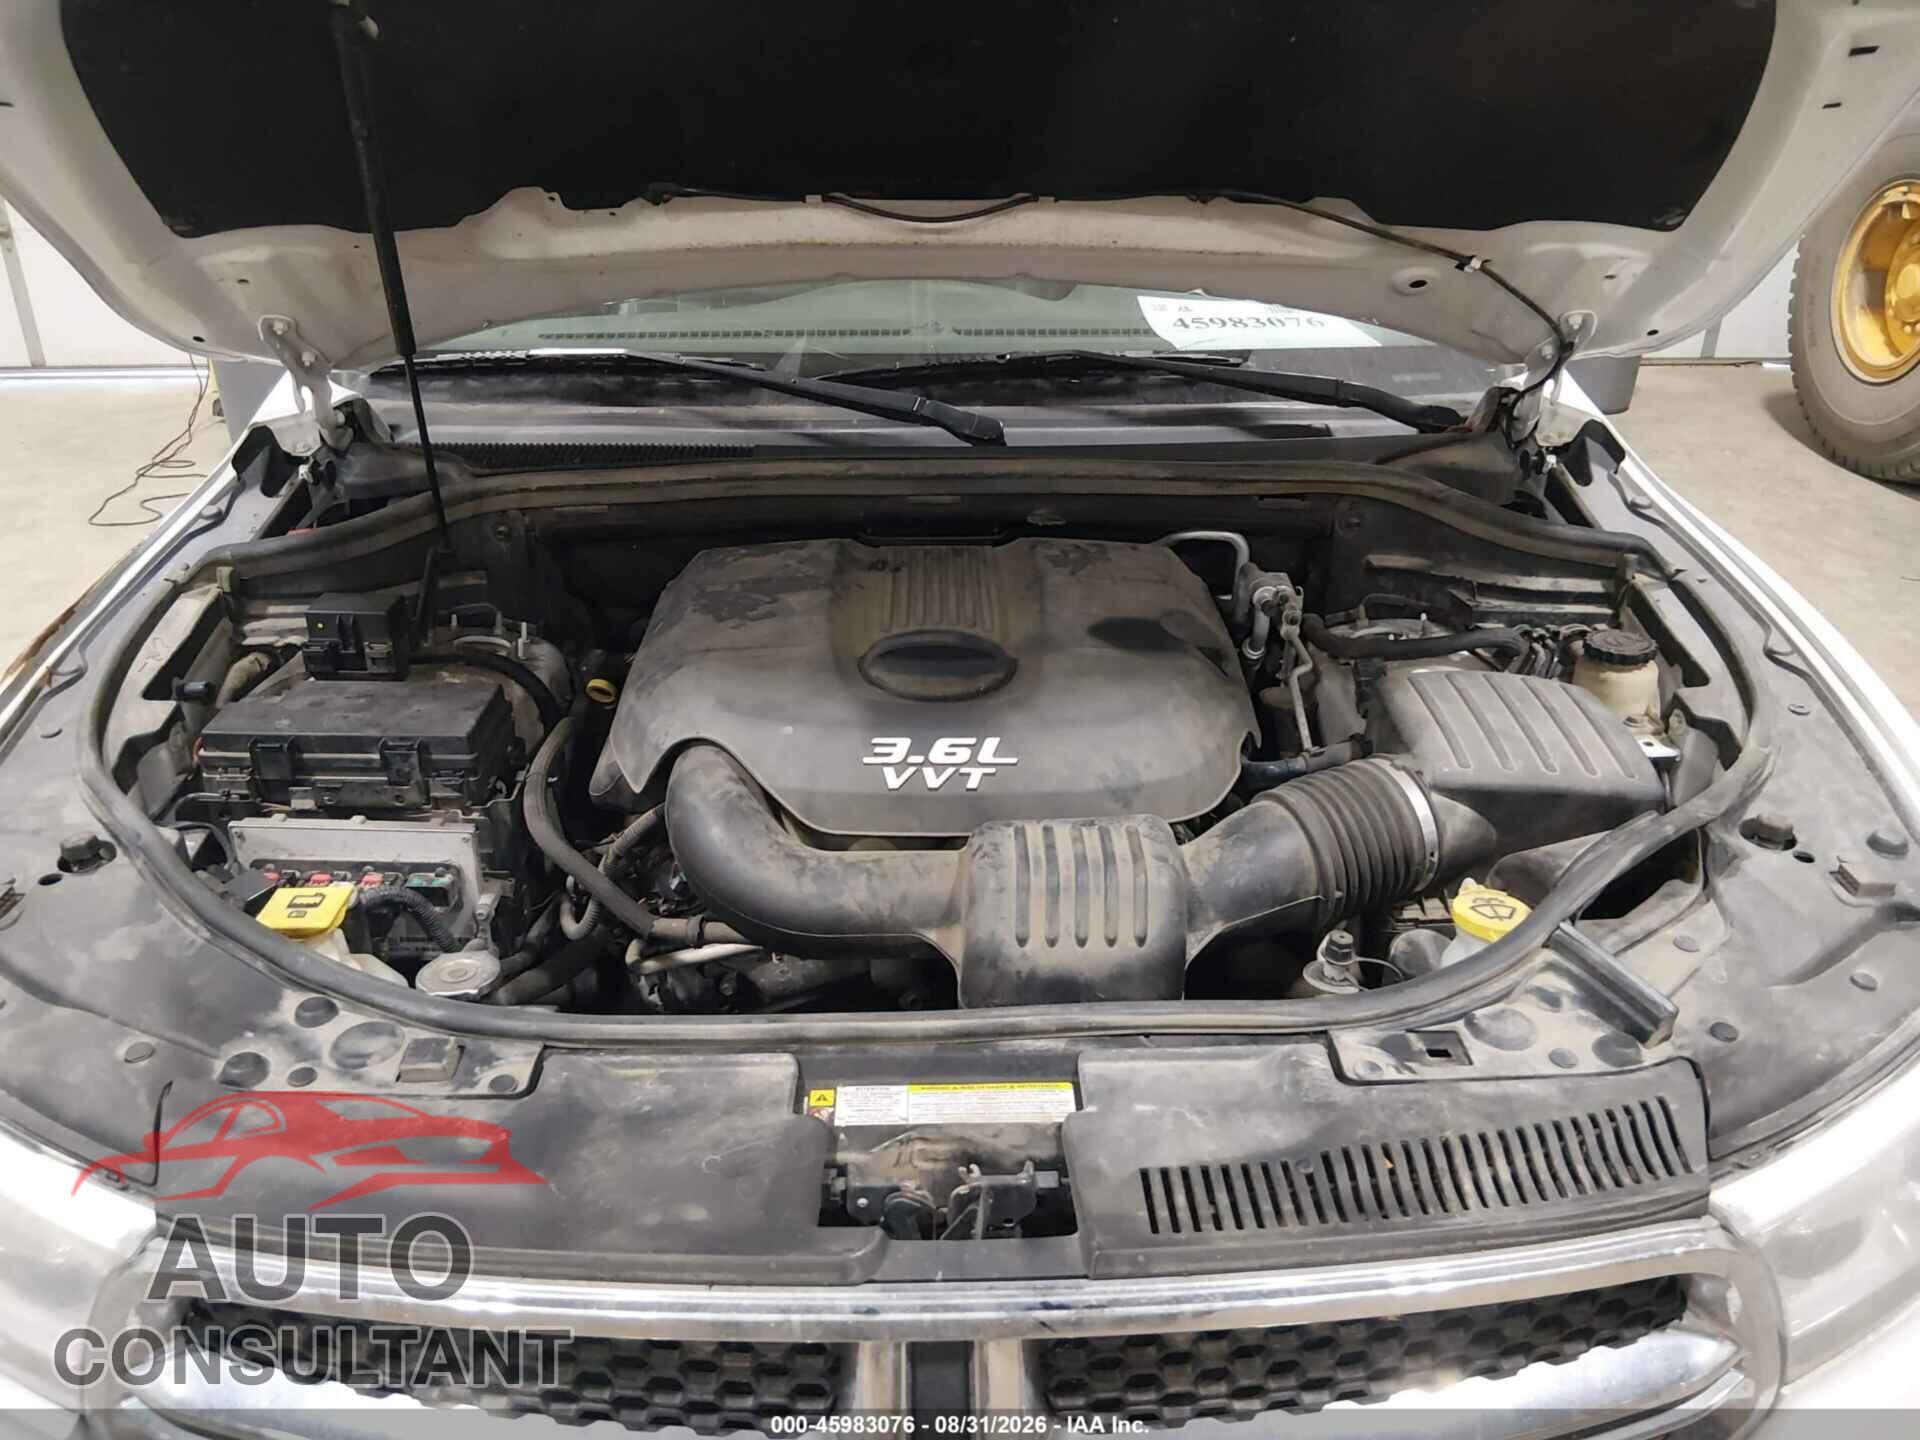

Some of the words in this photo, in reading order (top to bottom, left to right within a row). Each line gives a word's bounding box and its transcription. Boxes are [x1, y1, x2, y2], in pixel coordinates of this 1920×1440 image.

[1172, 316, 1326, 330] 45983076
[862, 737, 1019, 766] 3.6L
[882, 766, 997, 791] VVT
